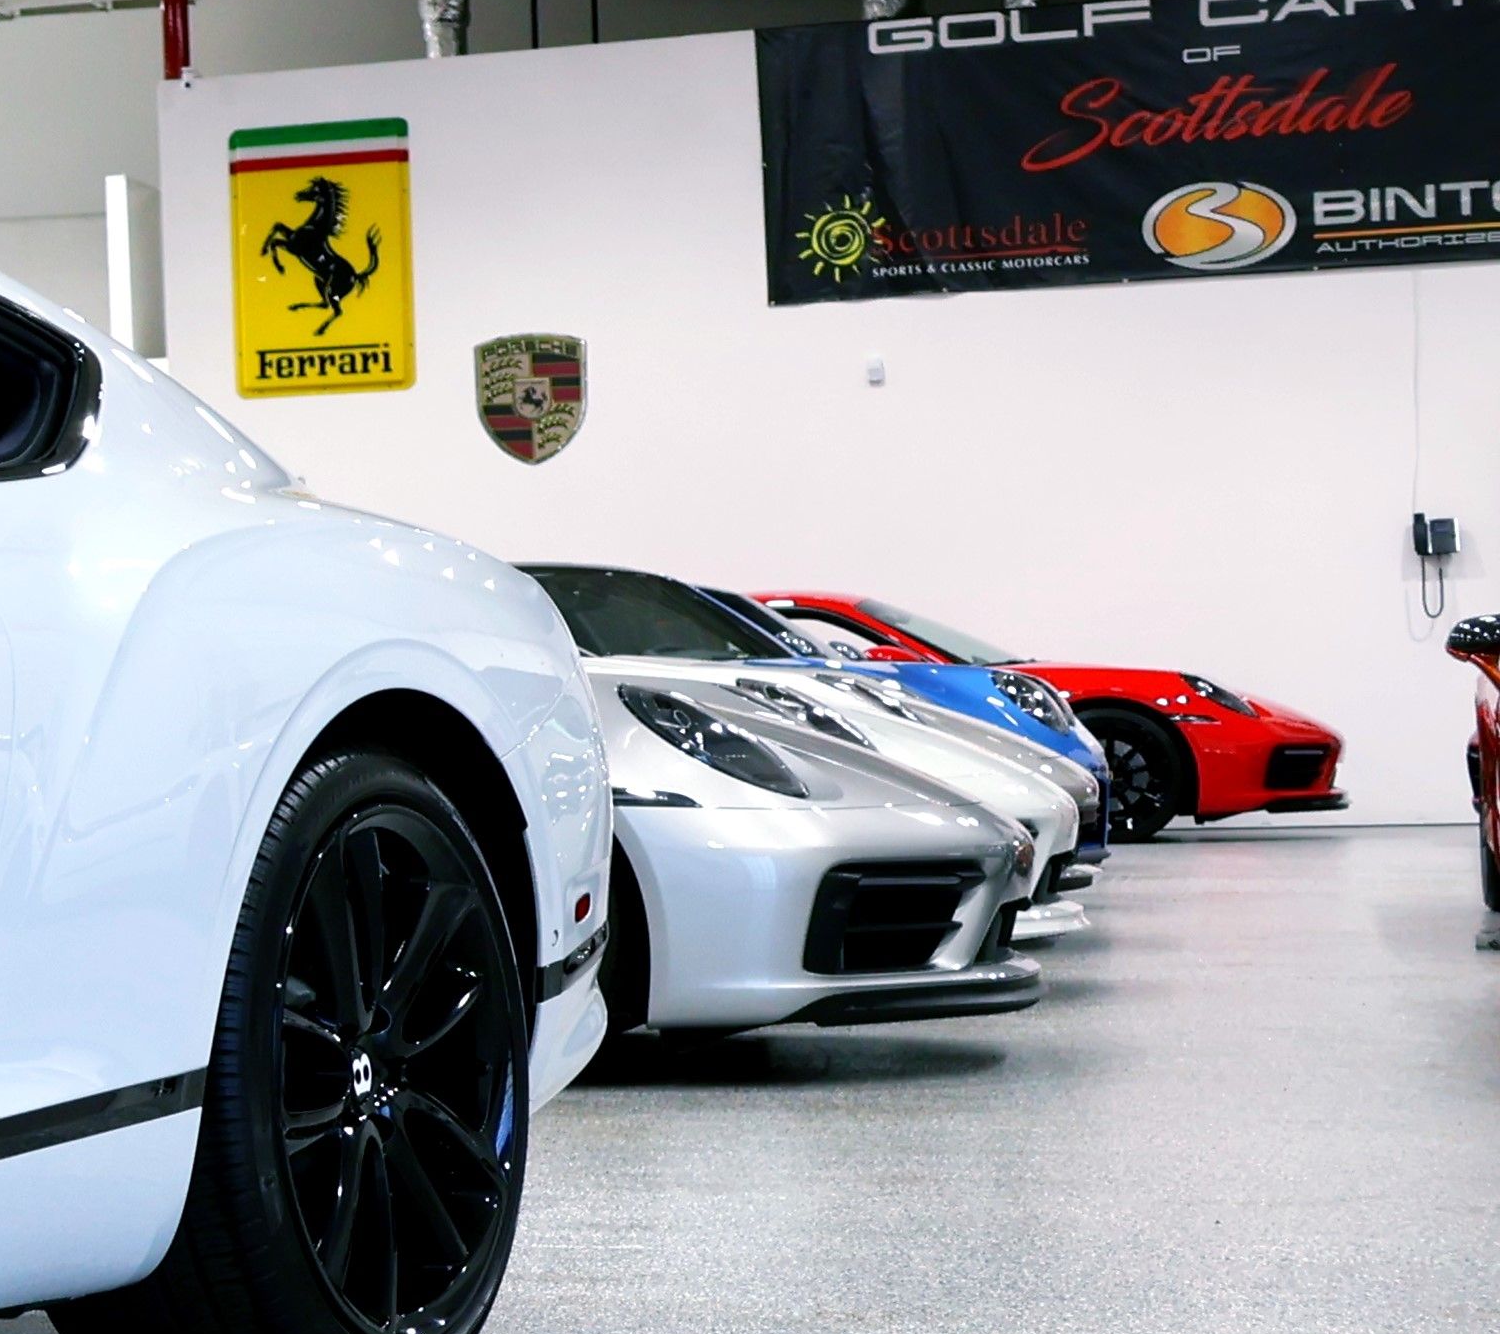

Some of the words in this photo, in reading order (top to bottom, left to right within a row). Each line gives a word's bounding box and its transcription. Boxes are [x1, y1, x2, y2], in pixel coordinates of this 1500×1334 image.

[1182, 44, 1241, 65] OF
[1020, 63, 1414, 172] Scottsdale
[1313, 180, 1500, 226] BINT
[871, 211, 1090, 254] Scottsdale
[872, 264, 922, 278] SPORTS
[927, 263, 935, 275] &
[941, 260, 996, 275] CLASSIC
[1002, 254, 1090, 269] MOTORCARS
[255, 343, 393, 380] Ferrari
